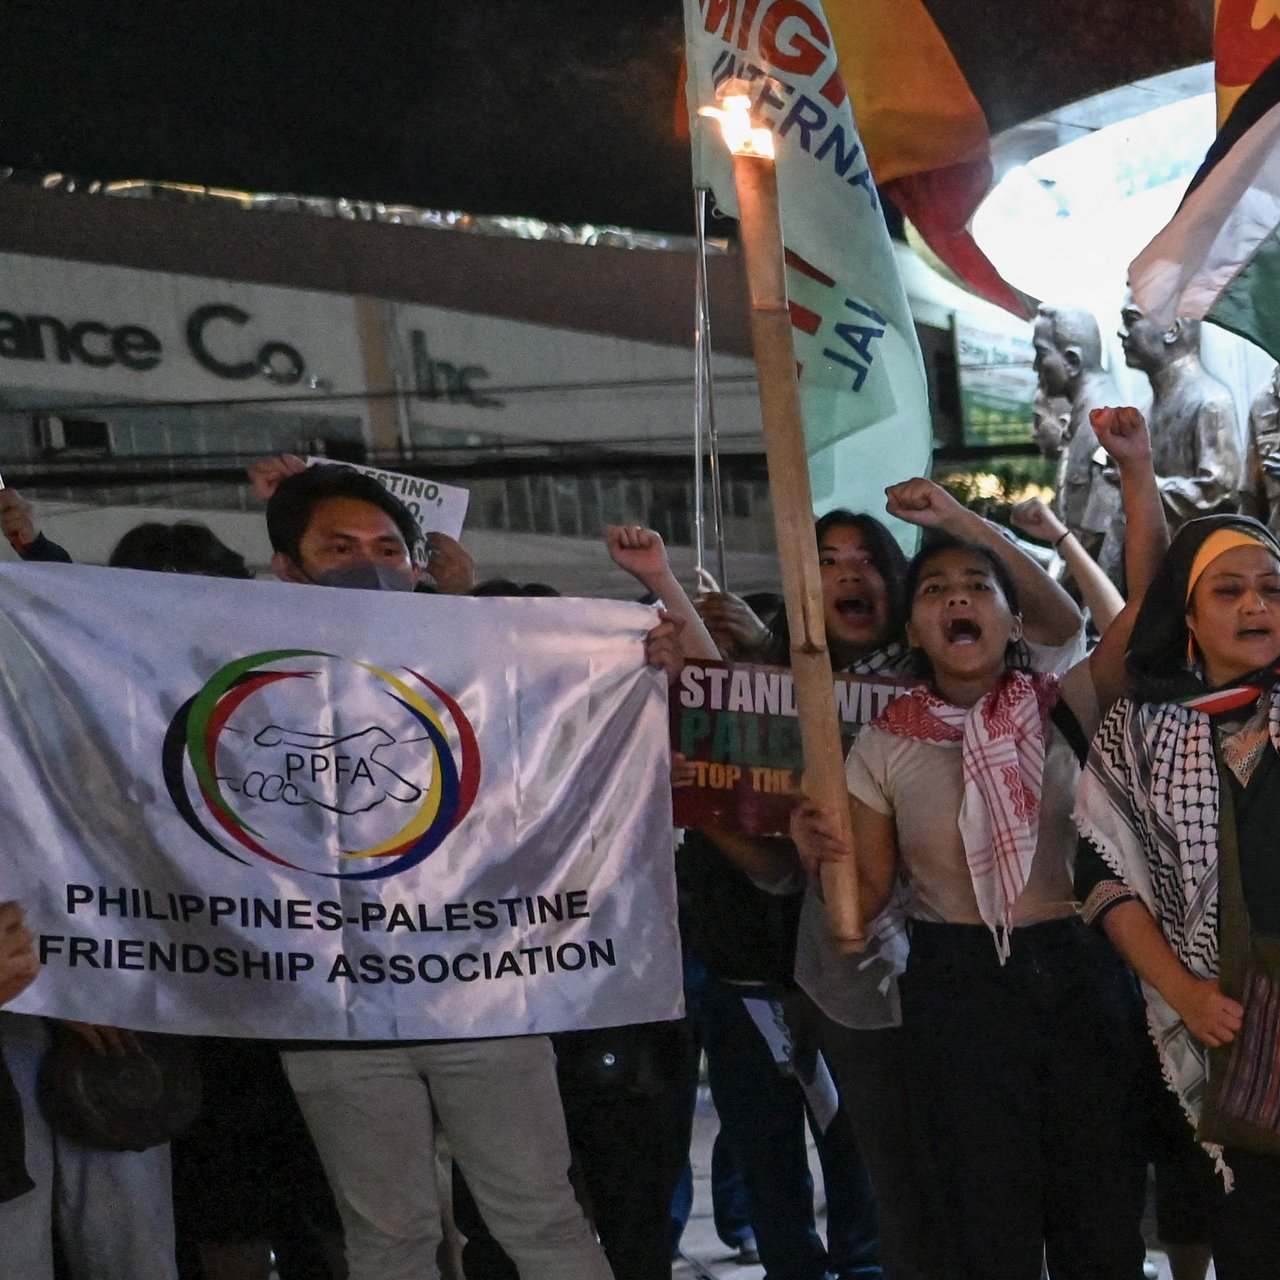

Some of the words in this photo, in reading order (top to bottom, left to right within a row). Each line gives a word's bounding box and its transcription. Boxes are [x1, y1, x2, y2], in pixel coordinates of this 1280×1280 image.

[285, 753, 377, 787] PPFA
[696, 762, 742, 790] TOP
[65, 883, 591, 934] PHILIPPINES-PALESTINE
[39, 934, 315, 983] FRIENDSHIP
[327, 938, 617, 985] ASSOCIATION
